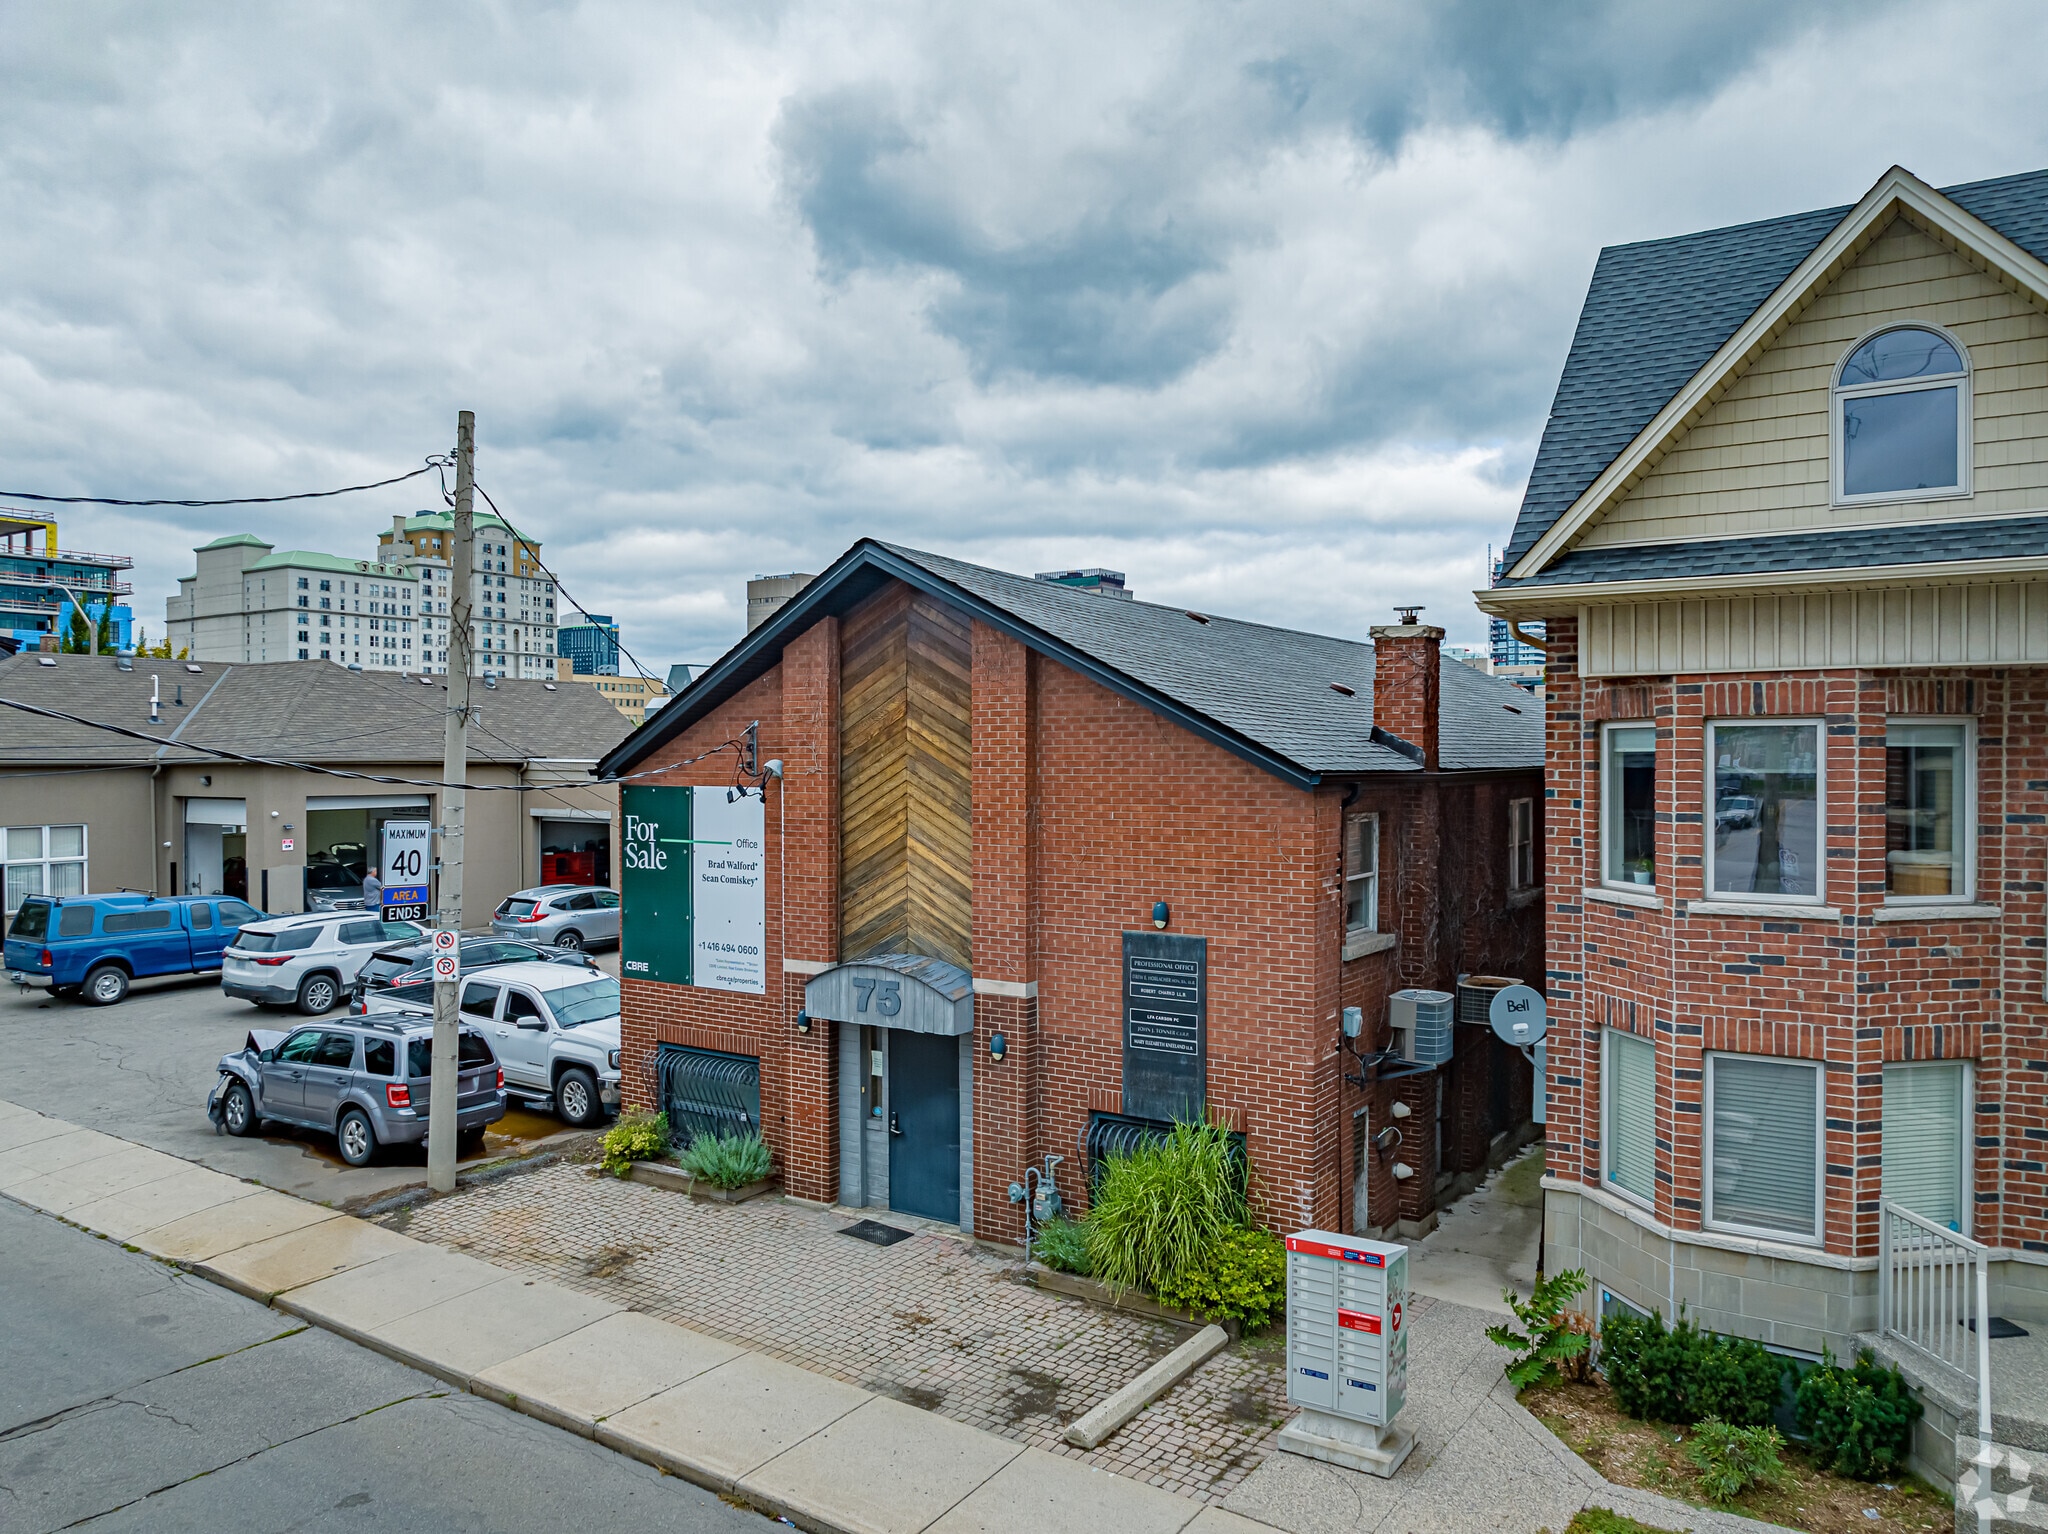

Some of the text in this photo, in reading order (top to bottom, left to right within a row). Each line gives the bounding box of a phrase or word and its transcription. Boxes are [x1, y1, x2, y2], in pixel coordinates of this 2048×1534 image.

[389, 829, 427, 840] MAXIMUM
[625, 815, 659, 842] For
[736, 839, 758, 849] Office
[625, 841, 668, 871] Sale
[391, 849, 421, 877] 40
[708, 860, 726, 869] Brad
[702, 874, 719, 883] Sean
[392, 890, 419, 901] AREA
[388, 906, 421, 921] ENDS
[698, 941, 758, 955] +1 416 494 0600
[625, 960, 649, 972] CBRE
[1134, 960, 1173, 970] PROFESSIONAL
[716, 974, 759, 986] cbre.ca/properties
[852, 976, 902, 1017] 75
[1506, 998, 1530, 1013] Bell
[1145, 1039, 1165, 1047] ELIZABETH
[1165, 1042, 1186, 1050] KNEELAND
[1291, 1239, 1297, 1250] 1
